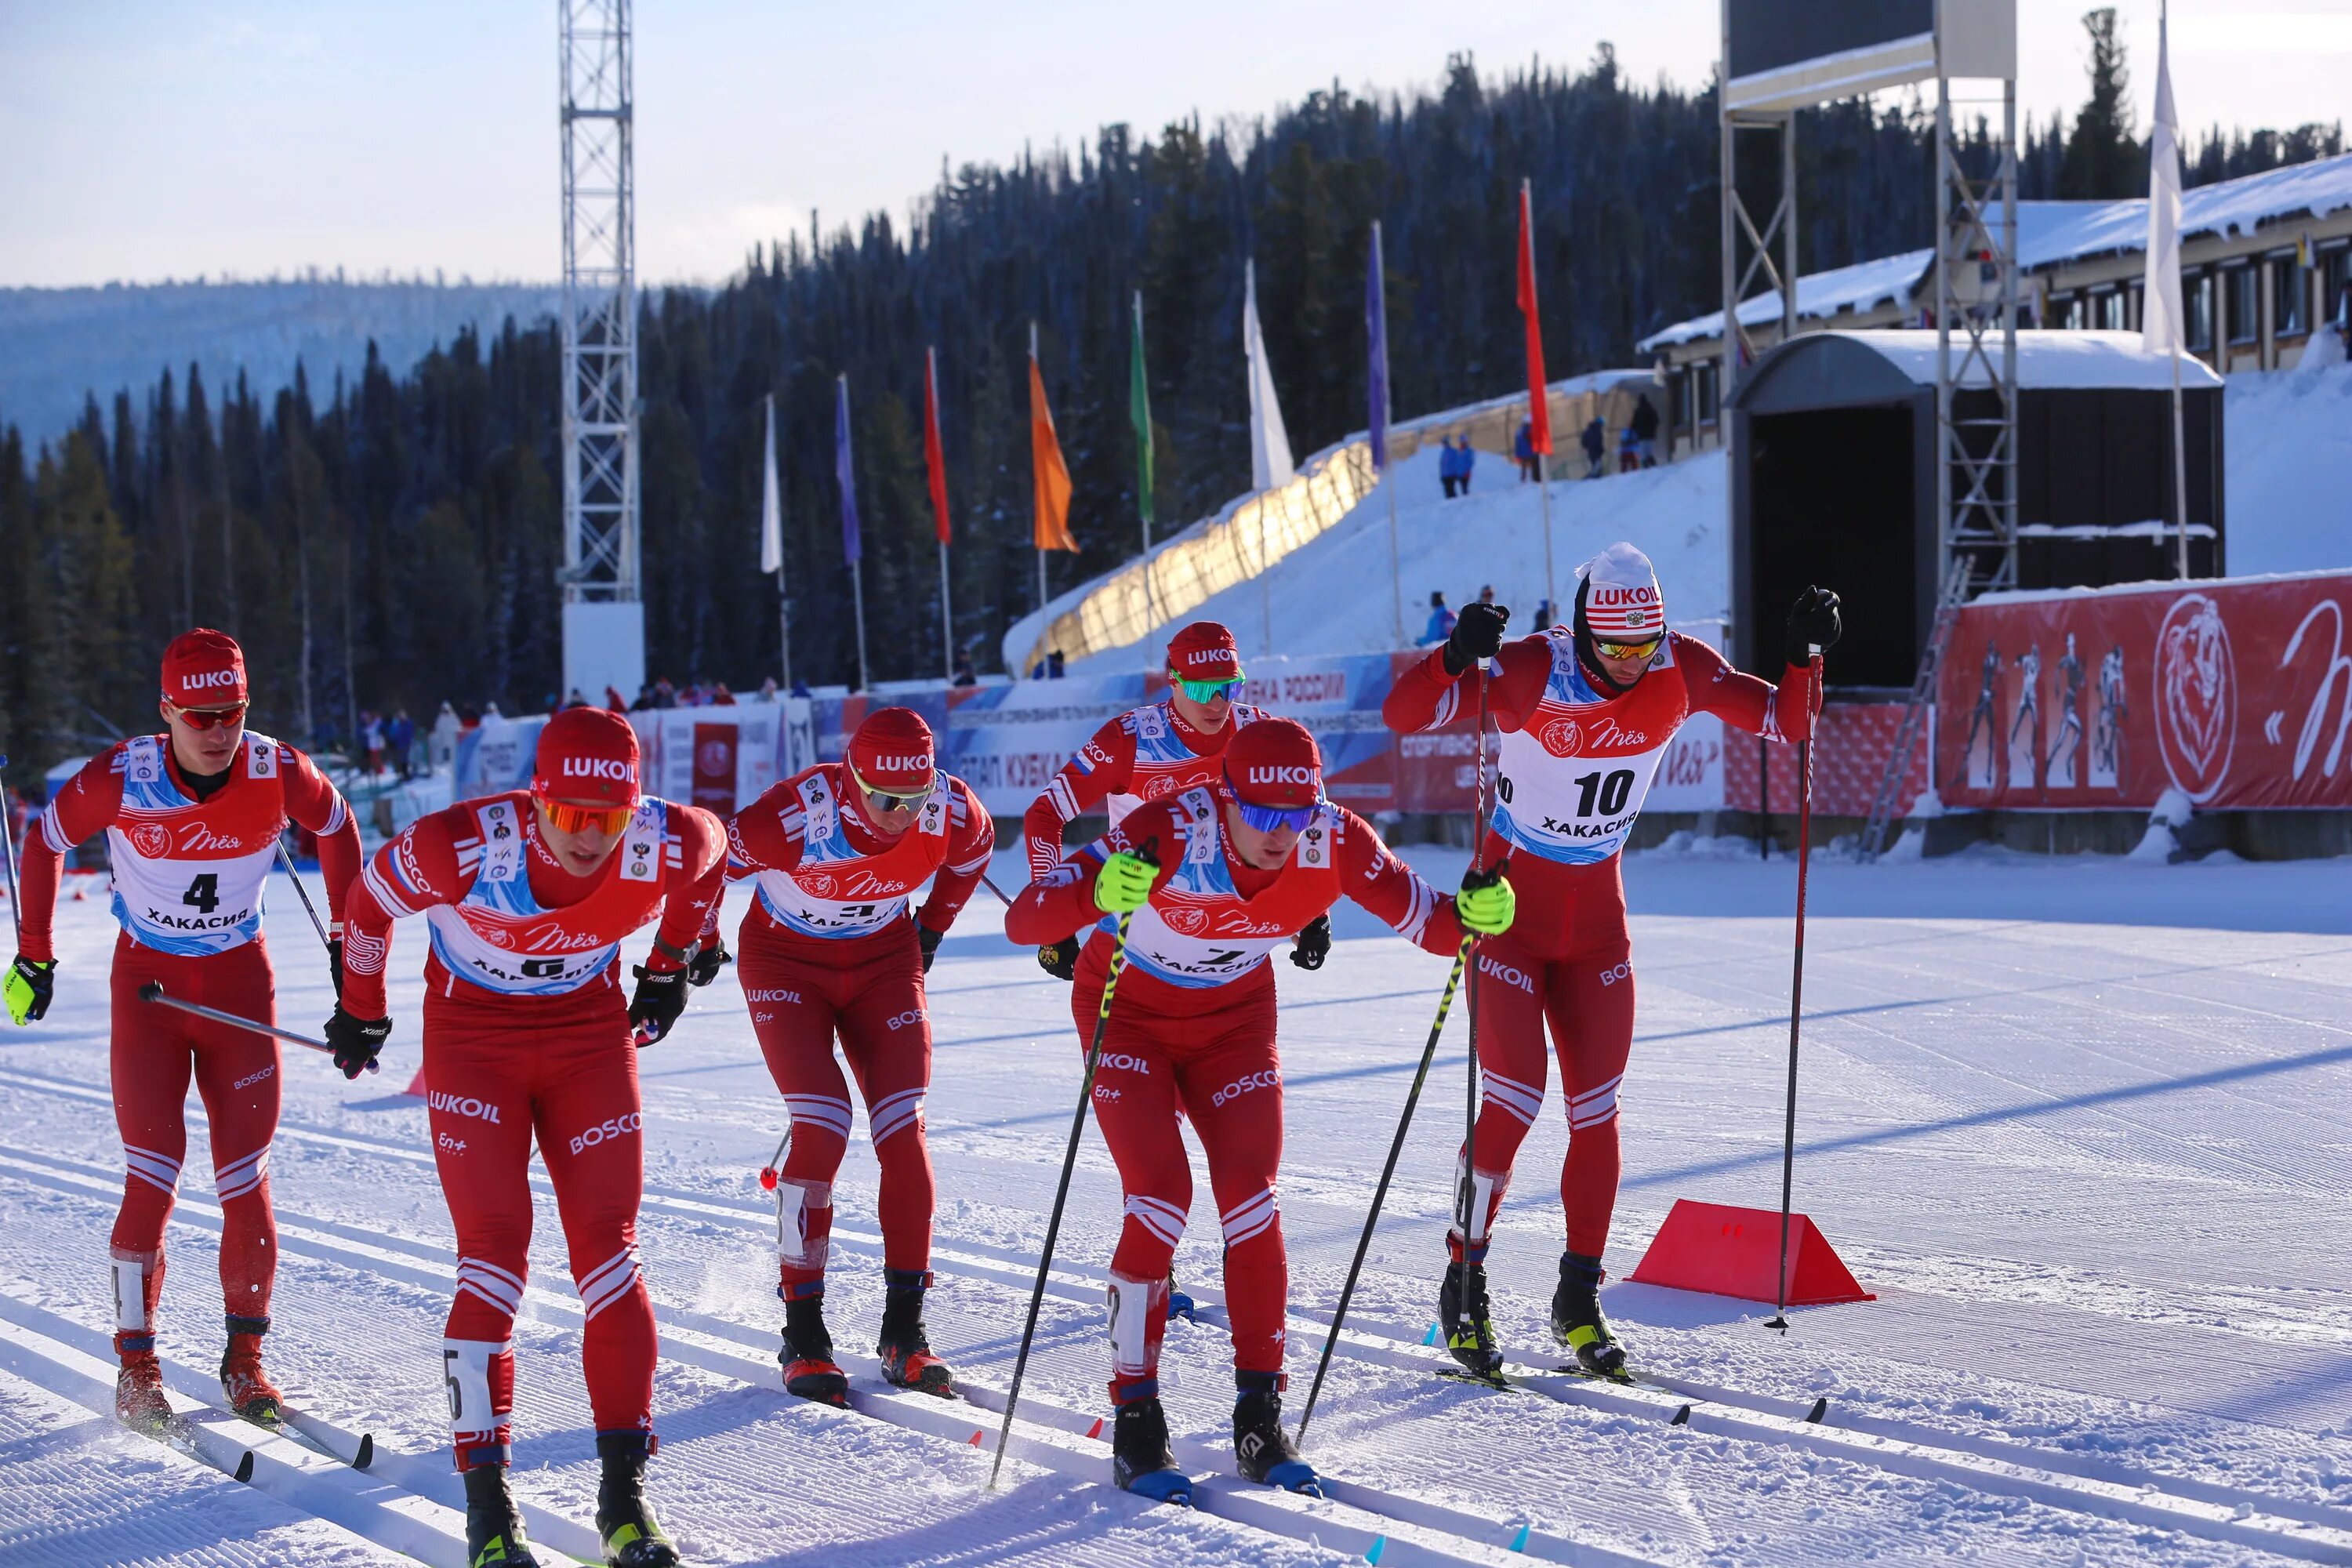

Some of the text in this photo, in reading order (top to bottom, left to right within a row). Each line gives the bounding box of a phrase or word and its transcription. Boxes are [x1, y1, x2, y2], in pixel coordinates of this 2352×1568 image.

[1594, 586, 1661, 605] LUKOIL
[183, 670, 245, 690] LUKOIL
[563, 757, 636, 783] LUKOIL
[1478, 731, 1486, 816] SWIX
[1574, 769, 1635, 818] 10
[1541, 810, 1638, 838] ХАКАСИЯ
[402, 824, 431, 893] BOSCO
[183, 873, 220, 914] 4
[147, 907, 249, 931] ХАКАСИЯ
[1478, 955, 1534, 994] UKOIL
[747, 989, 802, 1004] LUKOIL
[361, 1025, 389, 1036] SWIX
[234, 1069, 272, 1091] BOSCO
[1212, 1070, 1278, 1108] BOSCO
[430, 1090, 501, 1124] LUKOIL
[569, 1112, 642, 1156] BOSCO
[443, 1349, 463, 1421] 5
